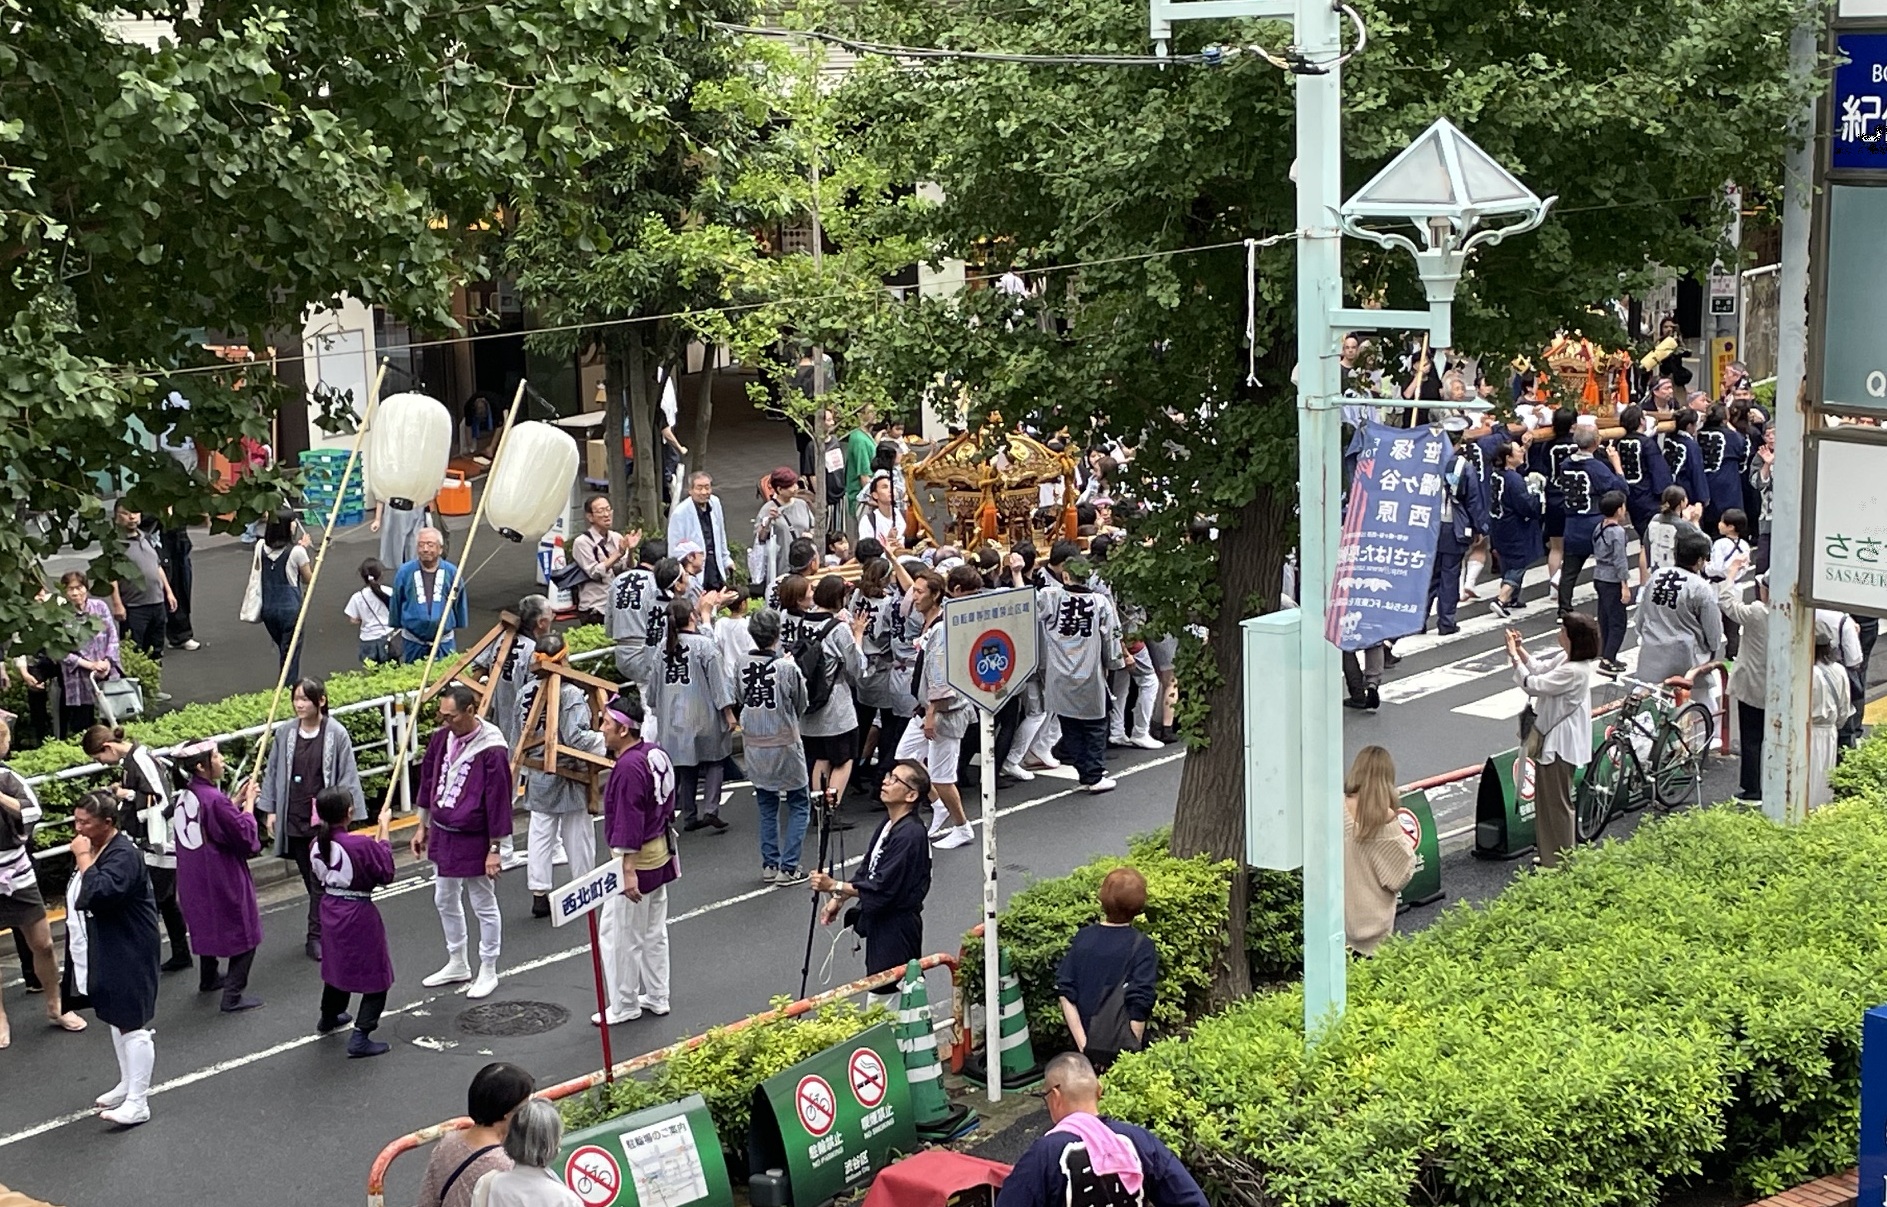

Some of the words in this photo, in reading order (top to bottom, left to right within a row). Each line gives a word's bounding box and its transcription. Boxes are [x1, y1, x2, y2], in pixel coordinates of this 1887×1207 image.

[1872, 64, 1887, 82] B
[1825, 533, 1887, 563] ささ
[561, 872, 618, 917] 西北町会
[625, 1122, 687, 1150] 駐輪場のご案内
[808, 1131, 844, 1160] 駐輪禁止
[844, 1149, 869, 1176] 渋谷区
